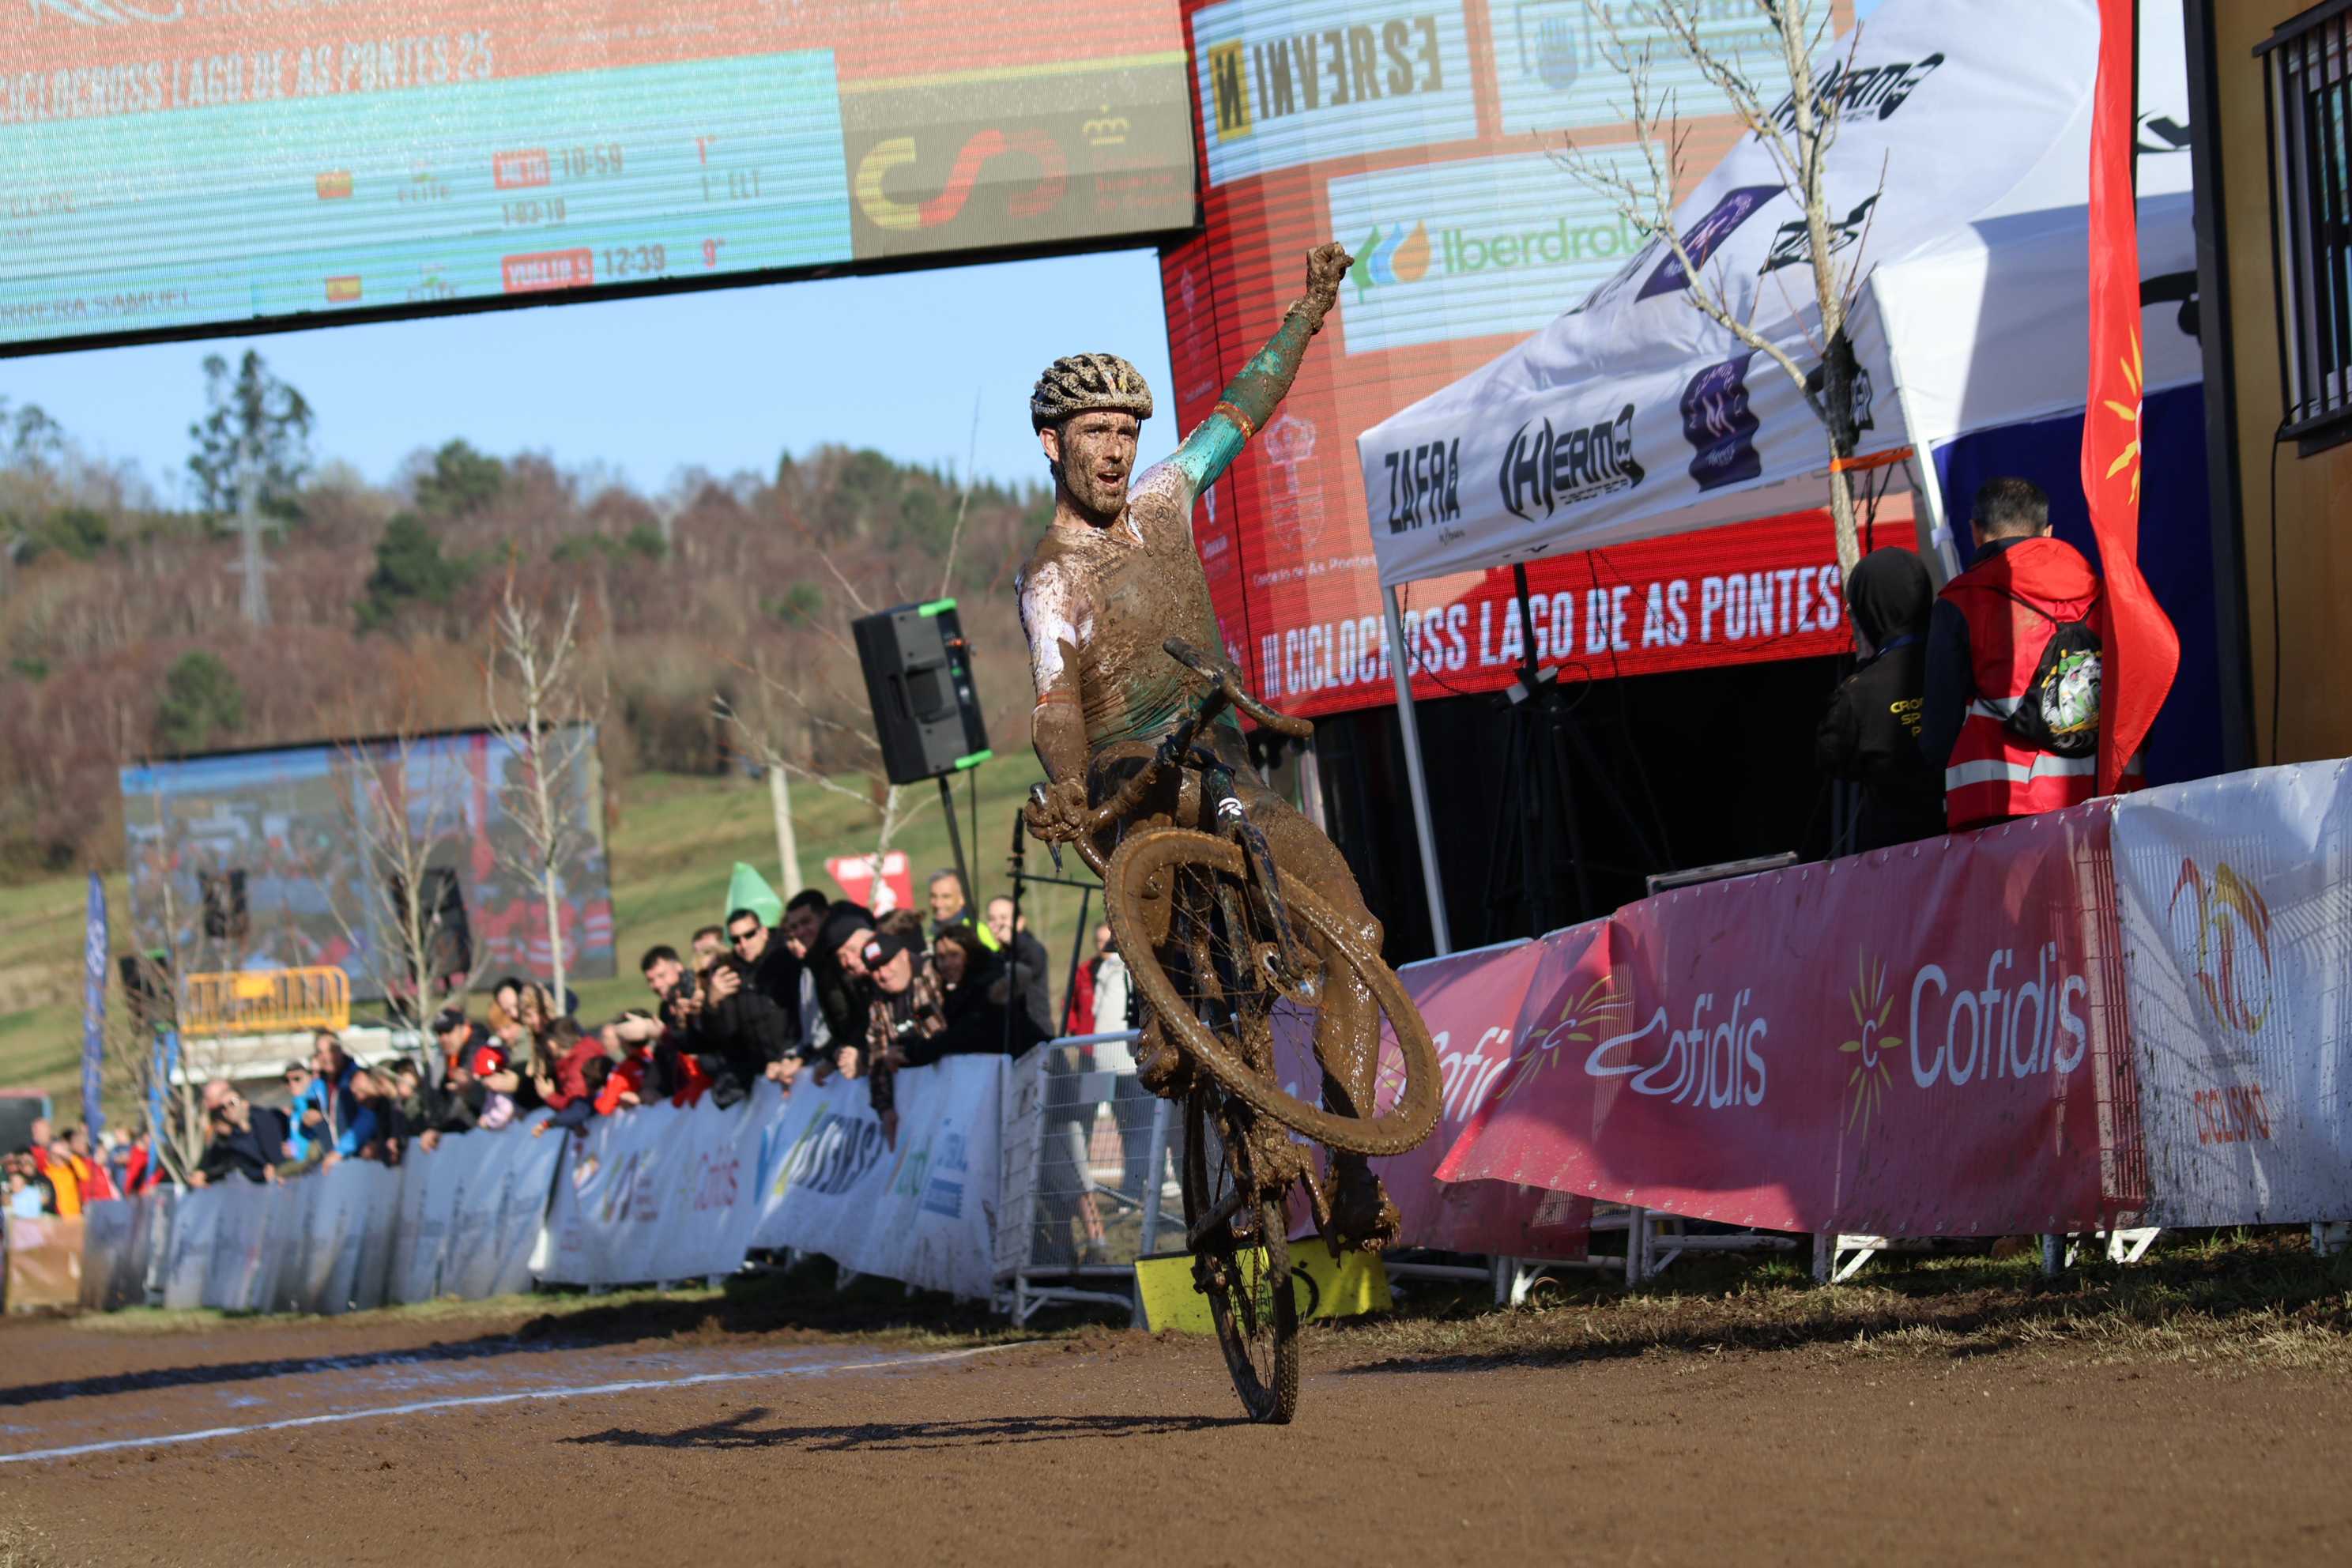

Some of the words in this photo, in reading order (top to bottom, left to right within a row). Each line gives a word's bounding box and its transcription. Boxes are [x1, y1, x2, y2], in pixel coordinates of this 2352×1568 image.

[296, 43, 333, 96] AS
[1385, 437, 1461, 535] ZAFRA
[1261, 633, 1281, 699] III
[1285, 604, 1468, 695] CICLOCROSS
[1479, 591, 1574, 666] LAGO
[1585, 585, 1632, 655] DE
[1642, 579, 1689, 649] AS
[1700, 563, 1841, 644] PONTES
[1584, 988, 1767, 1110] Cofidis
[1909, 940, 2087, 1088] Cofidis
